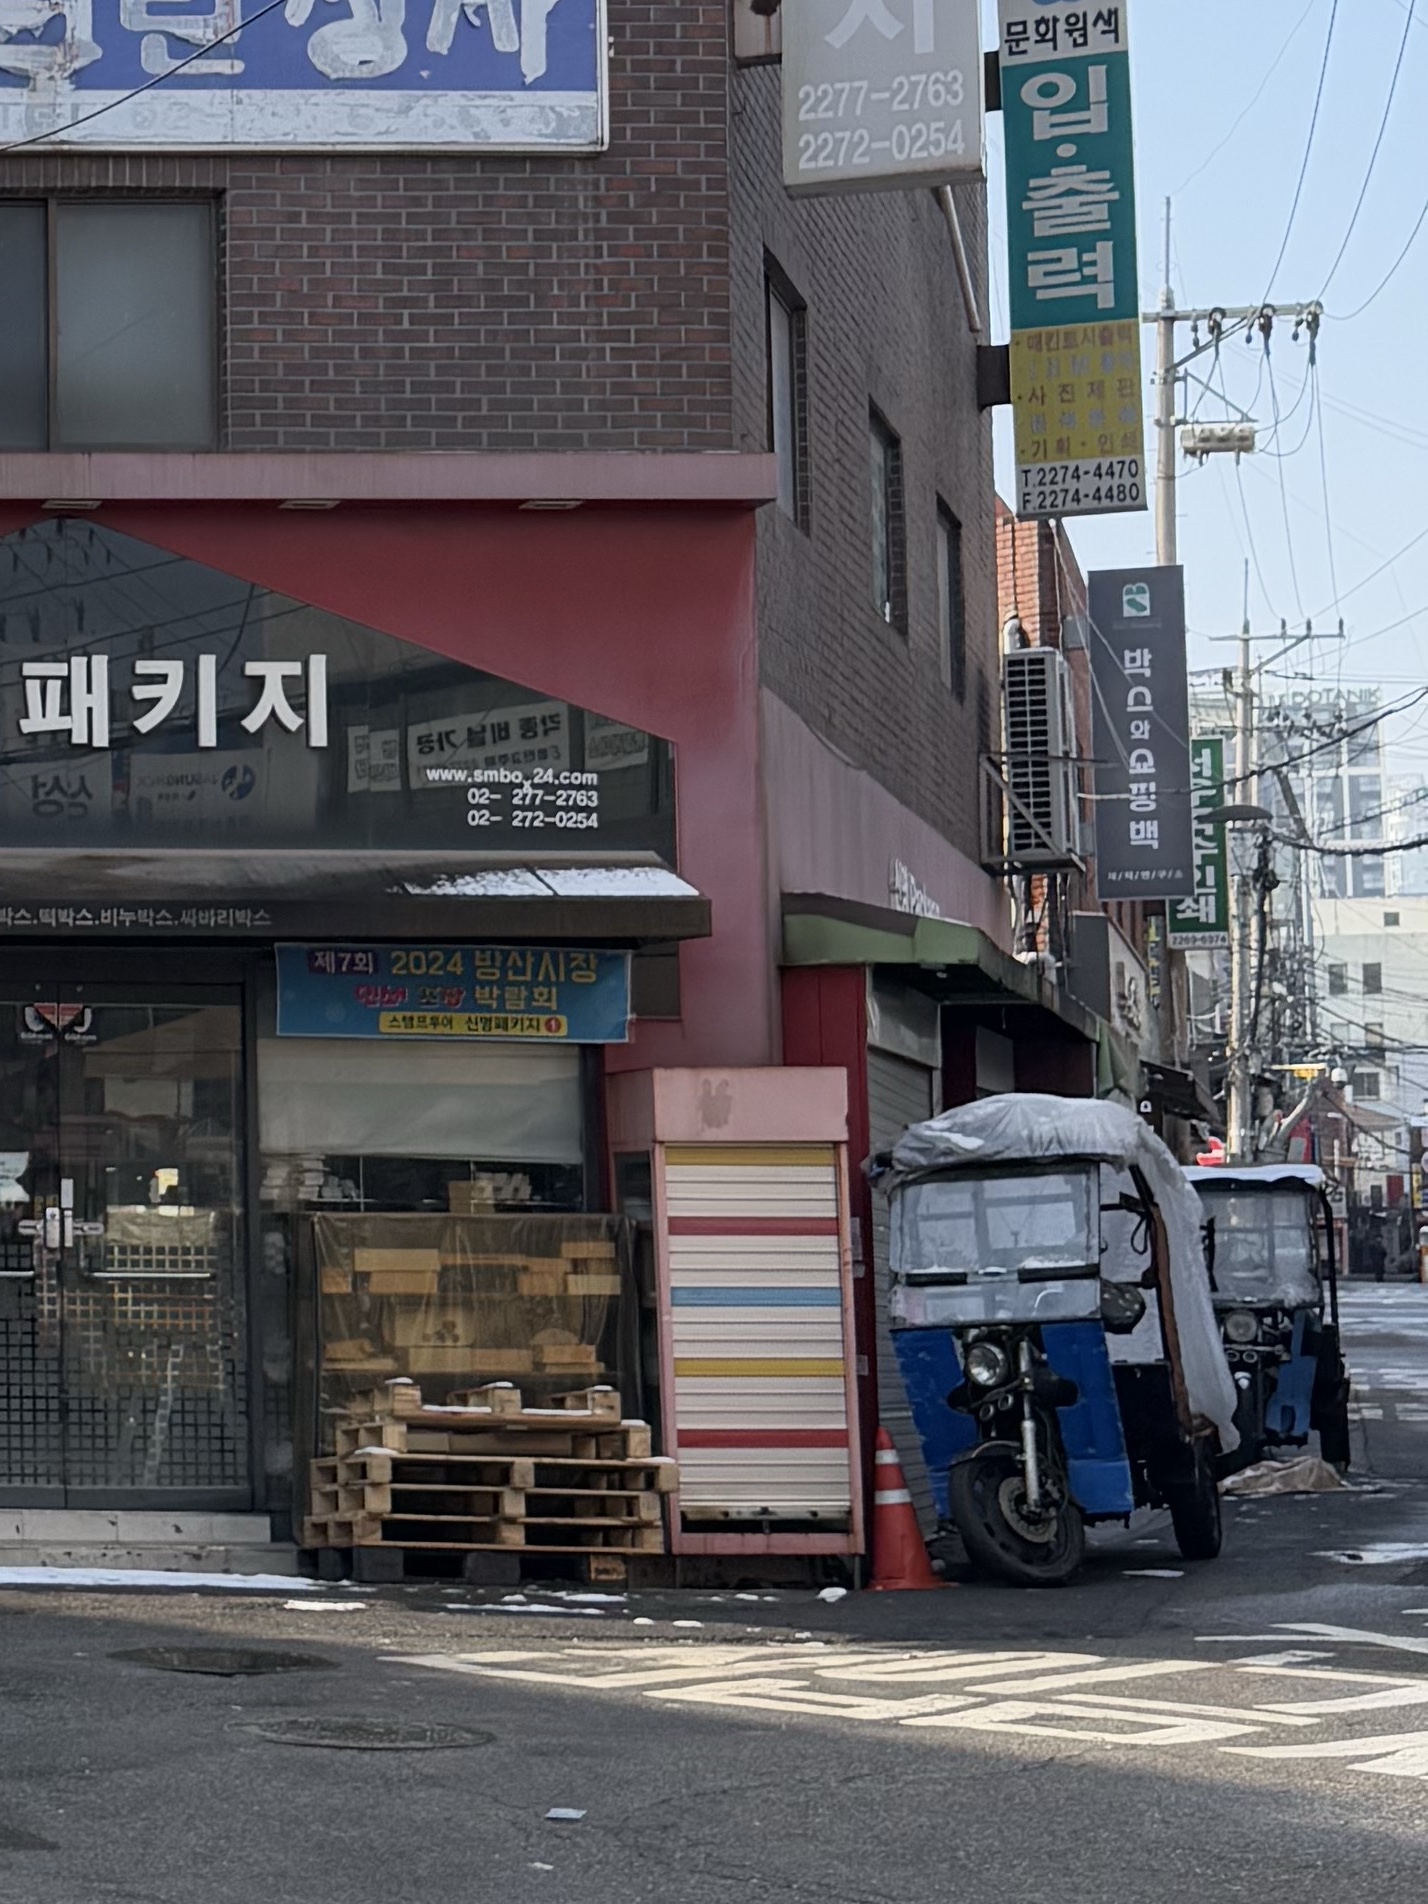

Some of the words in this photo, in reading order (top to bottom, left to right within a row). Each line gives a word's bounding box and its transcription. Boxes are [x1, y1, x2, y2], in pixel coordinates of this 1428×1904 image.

[1004, 7, 1120, 57] 문화원색
[796, 71, 966, 123] 2277-2763
[796, 123, 967, 171] 2272-0254
[1021, 458, 1139, 489] T.2274-4470
[1022, 482, 1140, 512] F.2274-4480
[390, 951, 465, 977] 2024
[475, 949, 598, 984] 방산시장
[475, 985, 559, 1012] 박람회
